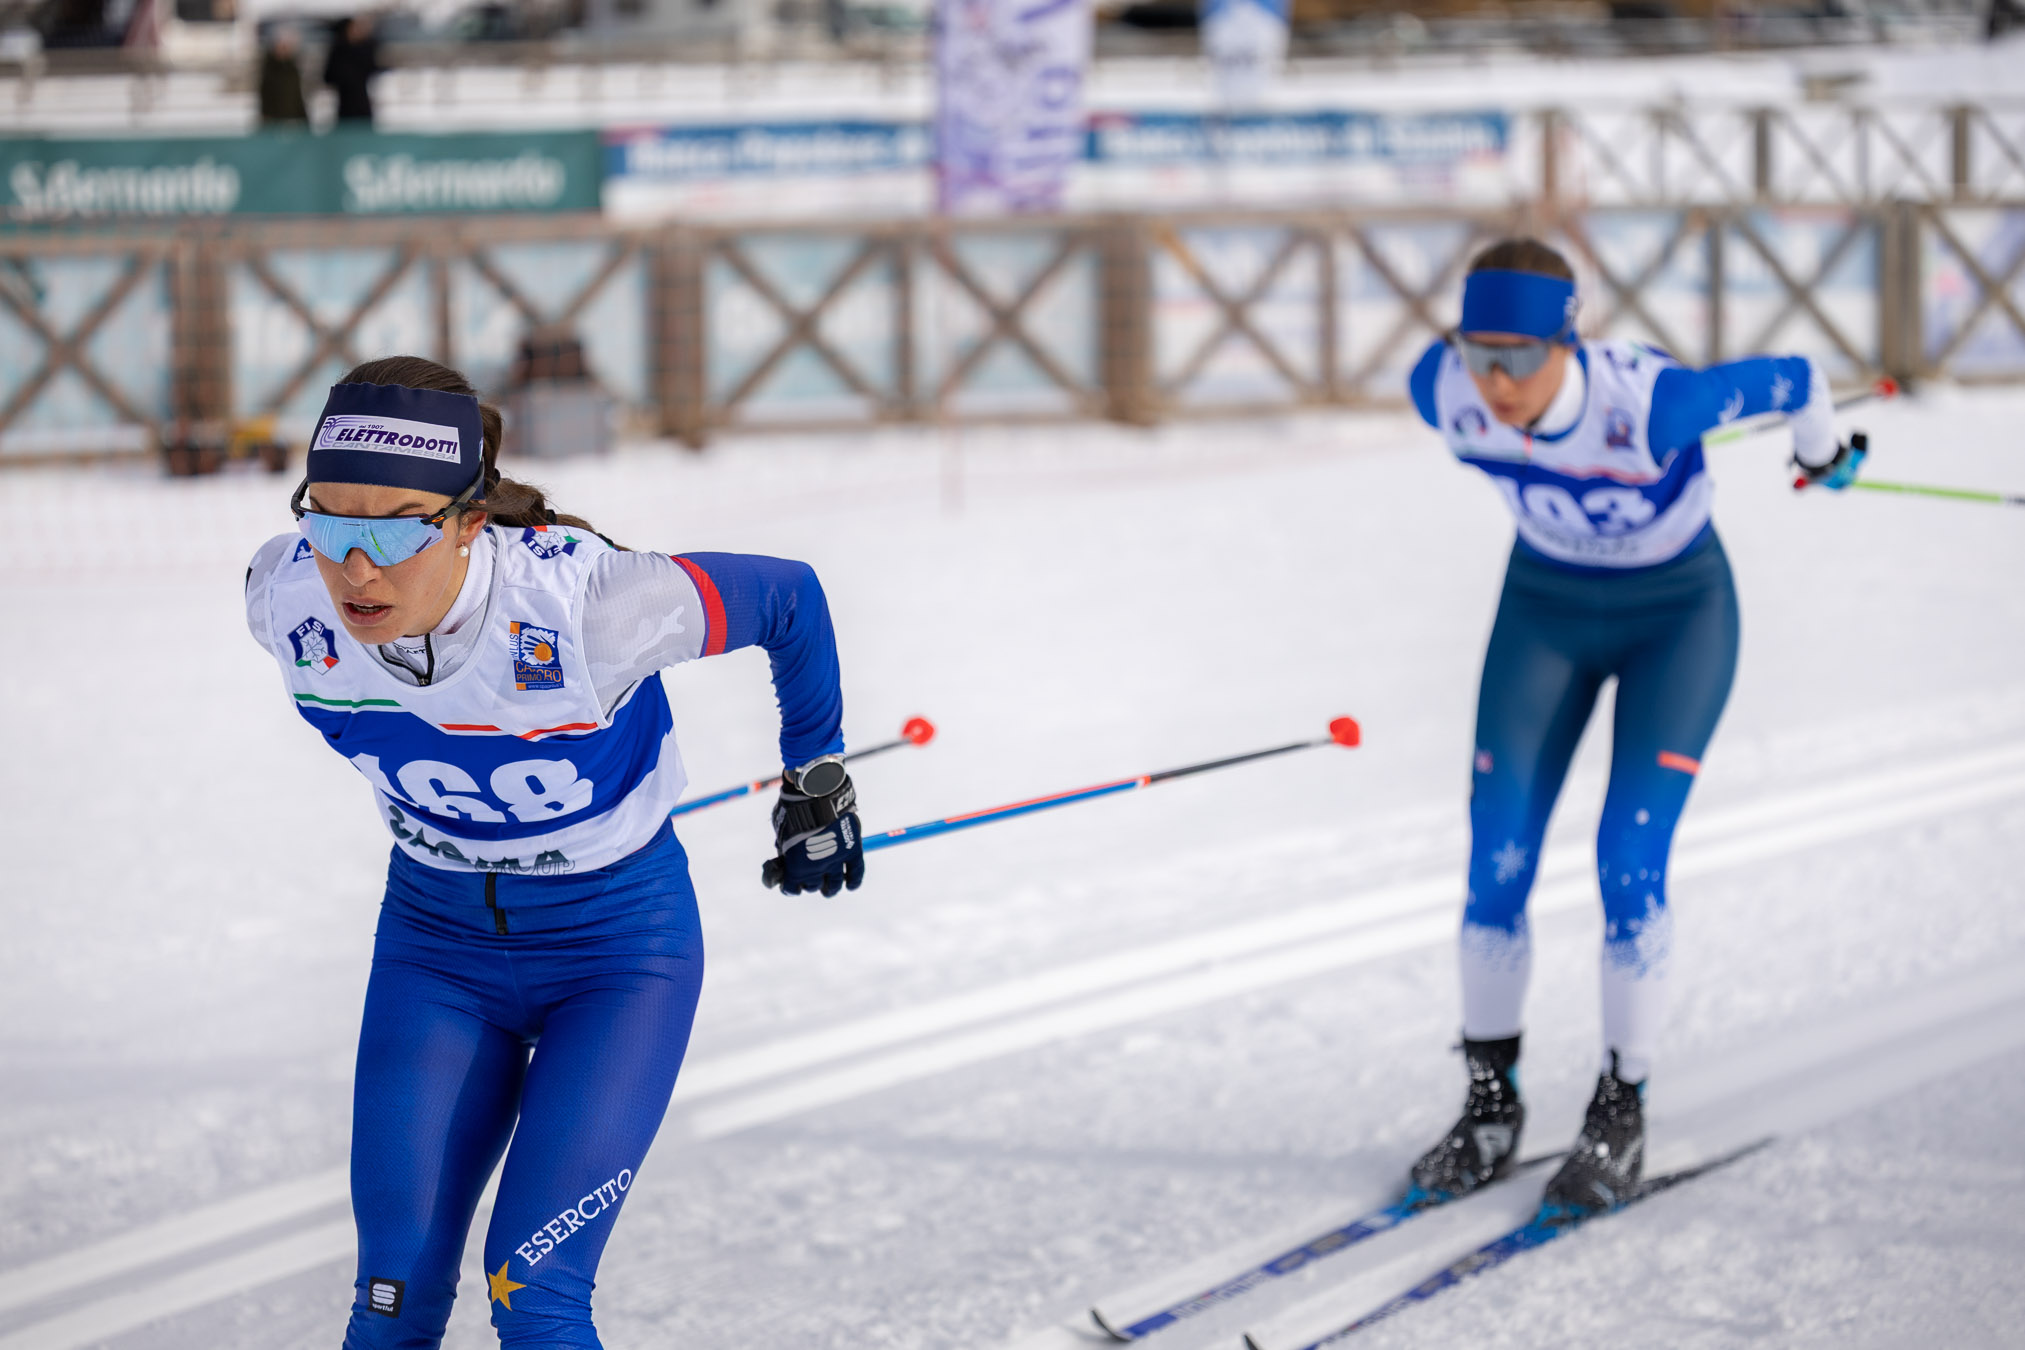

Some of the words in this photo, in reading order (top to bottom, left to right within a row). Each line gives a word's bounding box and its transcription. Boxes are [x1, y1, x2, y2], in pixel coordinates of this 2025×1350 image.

[332, 441, 455, 461] CANTAMESSA
[335, 428, 458, 455] ELETTRODOTTI
[515, 1168, 632, 1266] ESERCITO
